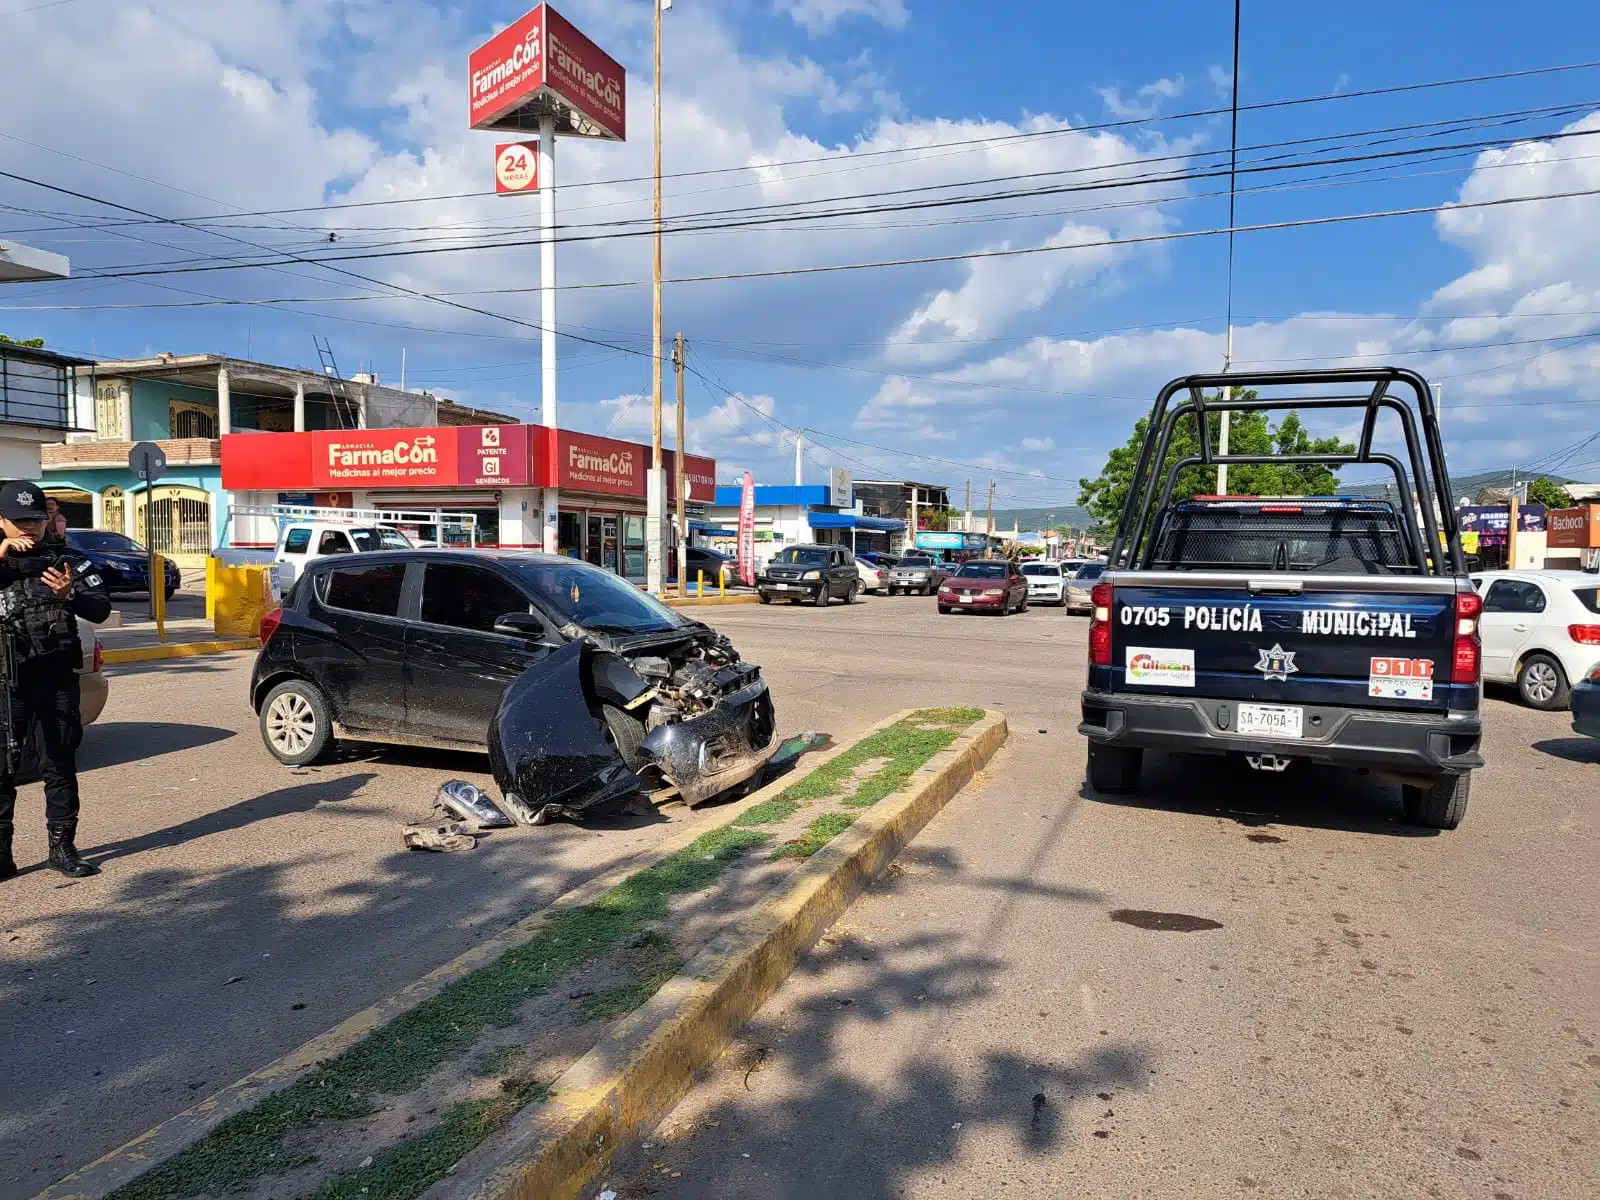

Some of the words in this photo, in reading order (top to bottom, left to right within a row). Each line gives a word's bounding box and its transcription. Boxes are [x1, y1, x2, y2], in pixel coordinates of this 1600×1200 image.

[504, 154, 527, 172] 24
[503, 173, 529, 181] HORAS
[477, 448, 508, 456] PATENTE
[330, 468, 371, 478] Medicinas
[373, 467, 380, 476] al
[382, 466, 407, 477] mejor
[409, 466, 437, 476] precio
[570, 470, 596, 482] Medicinas
[597, 474, 602, 483] al
[603, 475, 618, 486] mejor
[618, 479, 633, 487] precio
[684, 474, 714, 486] NSULTORIO
[1480, 512, 1522, 520] ABARROS
[1553, 515, 1584, 530] Bachoco
[1120, 606, 1170, 626] 0705
[1184, 603, 1263, 632] POLICÍA
[1302, 610, 1417, 638] MUNICIPAL
[1375, 661, 1427, 675] 911
[1240, 711, 1299, 728] SA-705A-1
